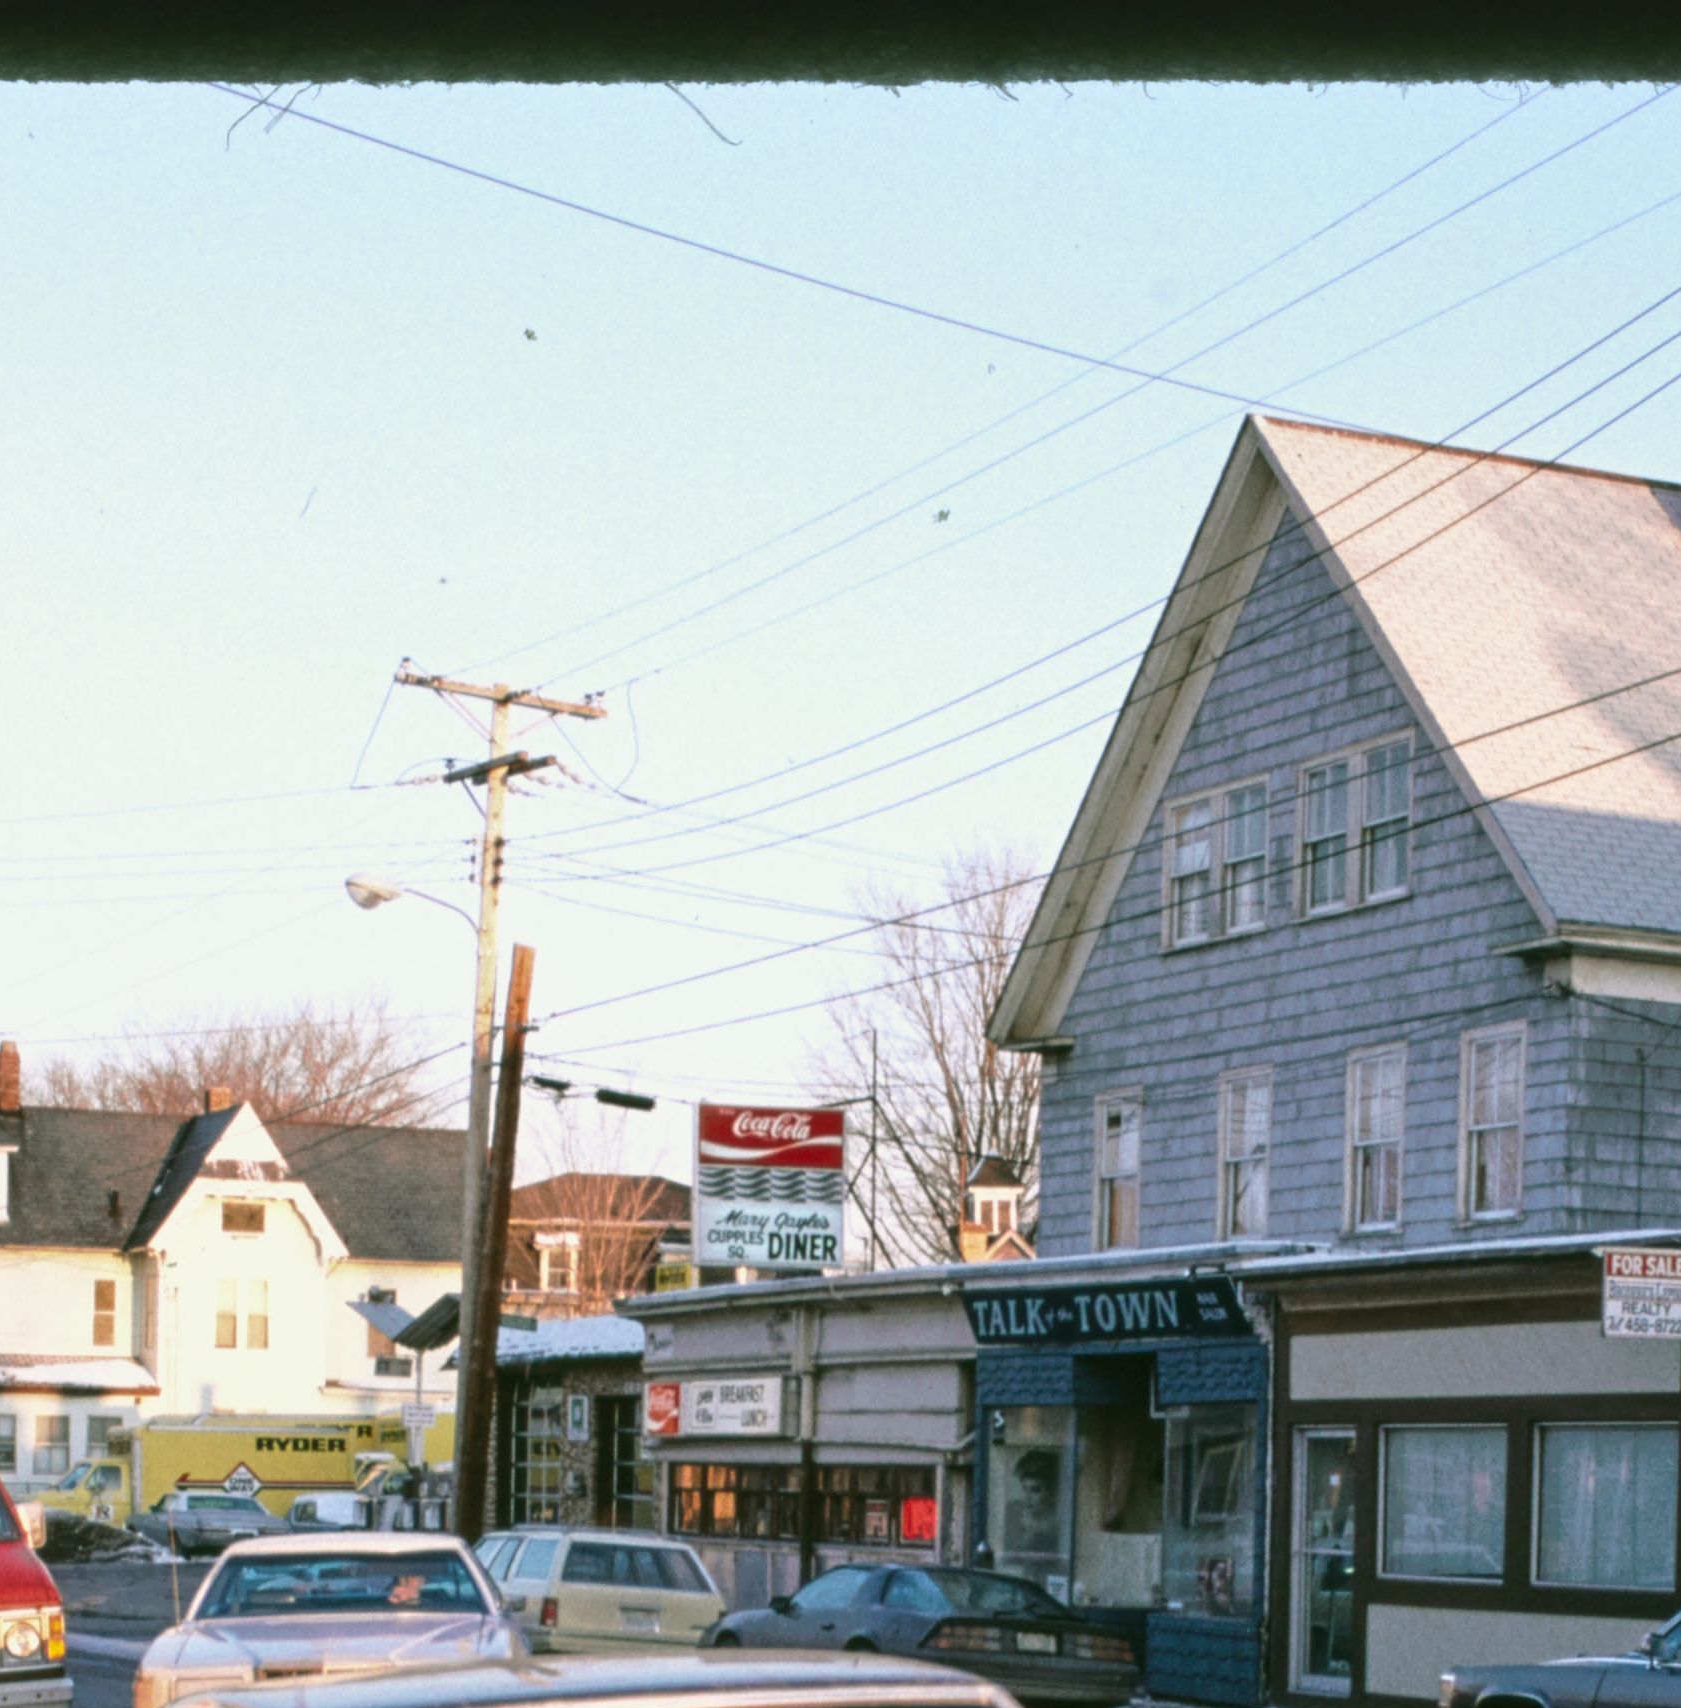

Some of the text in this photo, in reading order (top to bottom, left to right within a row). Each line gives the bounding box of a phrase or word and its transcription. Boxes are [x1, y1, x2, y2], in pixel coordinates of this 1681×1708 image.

[715, 1209, 771, 1231] Mary
[707, 1229, 765, 1246] CUPPLES
[767, 1233, 837, 1261] DINER
[1611, 1254, 1644, 1276] FOR
[972, 1298, 1048, 1337] TALK
[1074, 1290, 1180, 1334] TOWN
[1621, 1301, 1672, 1316] REALTY
[255, 1437, 347, 1453] RYDER
